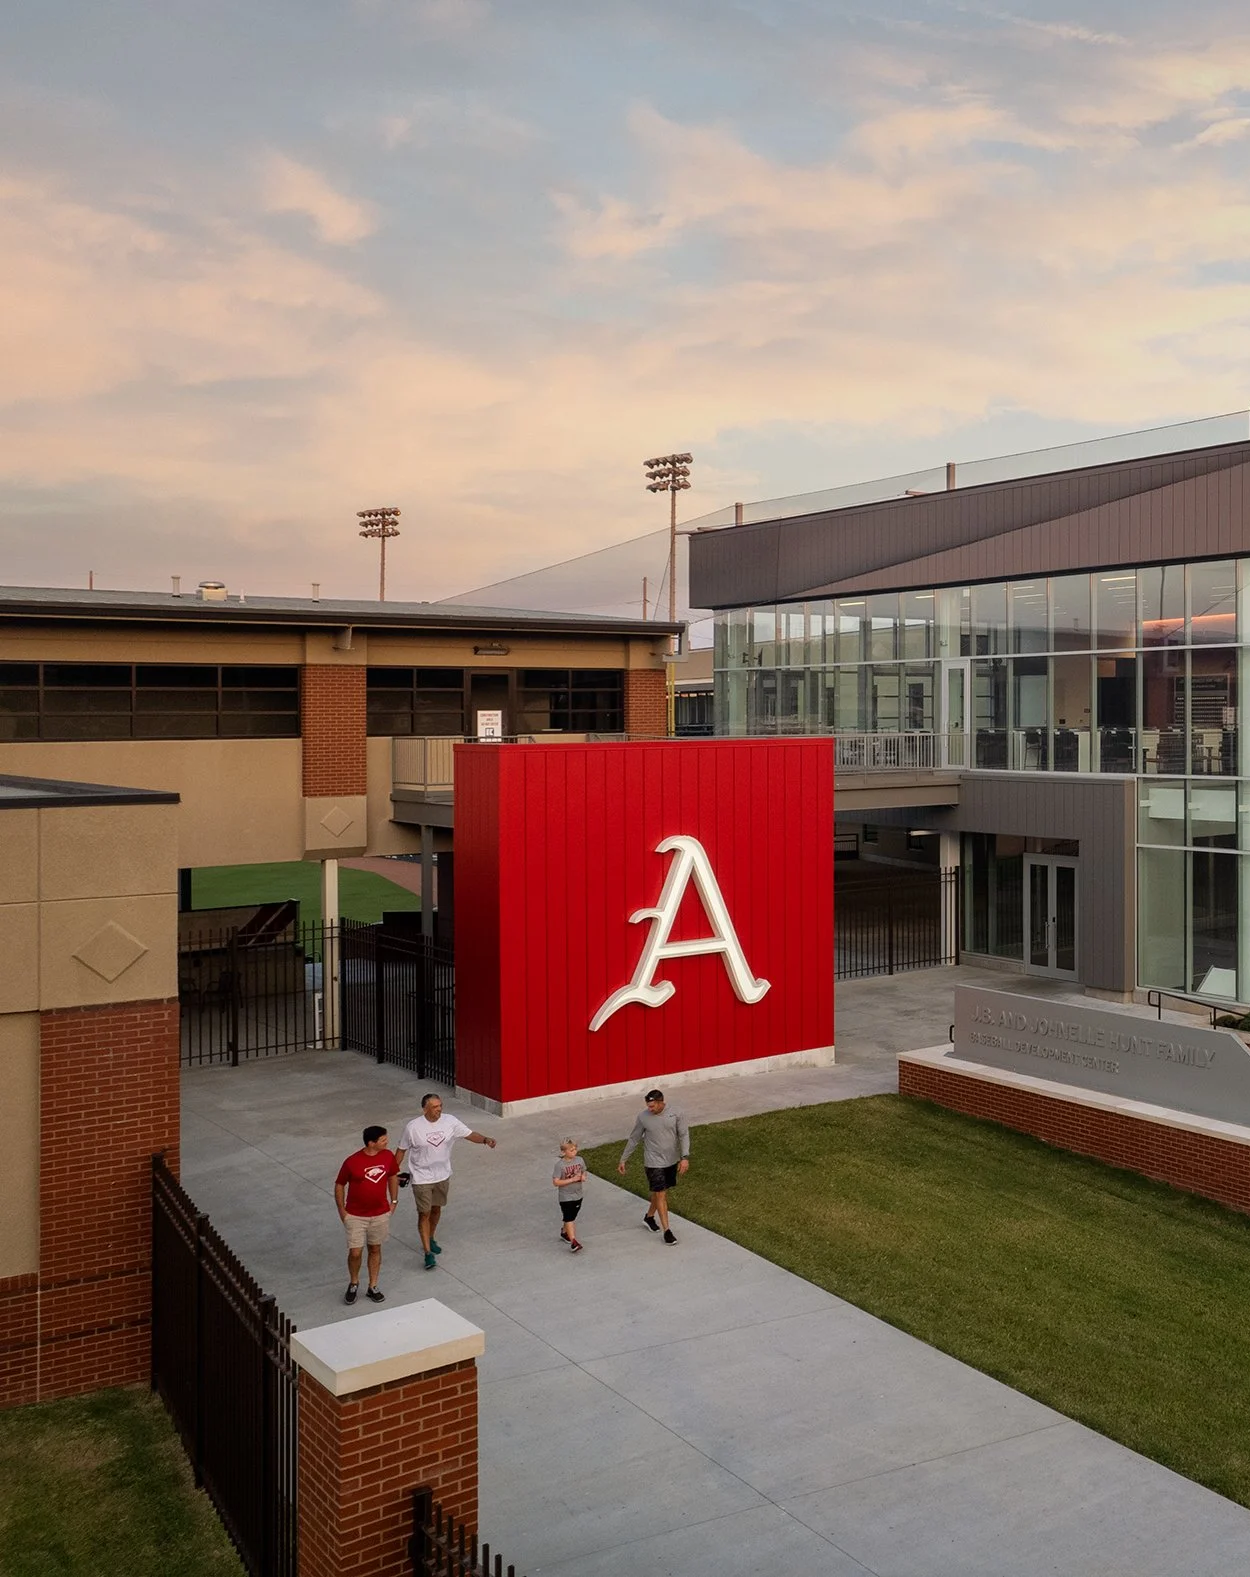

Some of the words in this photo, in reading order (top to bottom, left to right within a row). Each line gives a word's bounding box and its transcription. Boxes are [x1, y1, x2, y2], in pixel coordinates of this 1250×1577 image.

[589, 835, 772, 1032] A
[969, 1031, 1013, 1052] BASEBALL
[1015, 1041, 1081, 1065] DEVELOPMENT
[1082, 1055, 1120, 1074] CENTER
[972, 1005, 995, 1026] J.B.
[999, 1009, 1027, 1032] AND
[1030, 1017, 1105, 1048] JOHNELLE
[1109, 1030, 1154, 1057] HUNT
[1156, 1040, 1216, 1069] FAMILY
